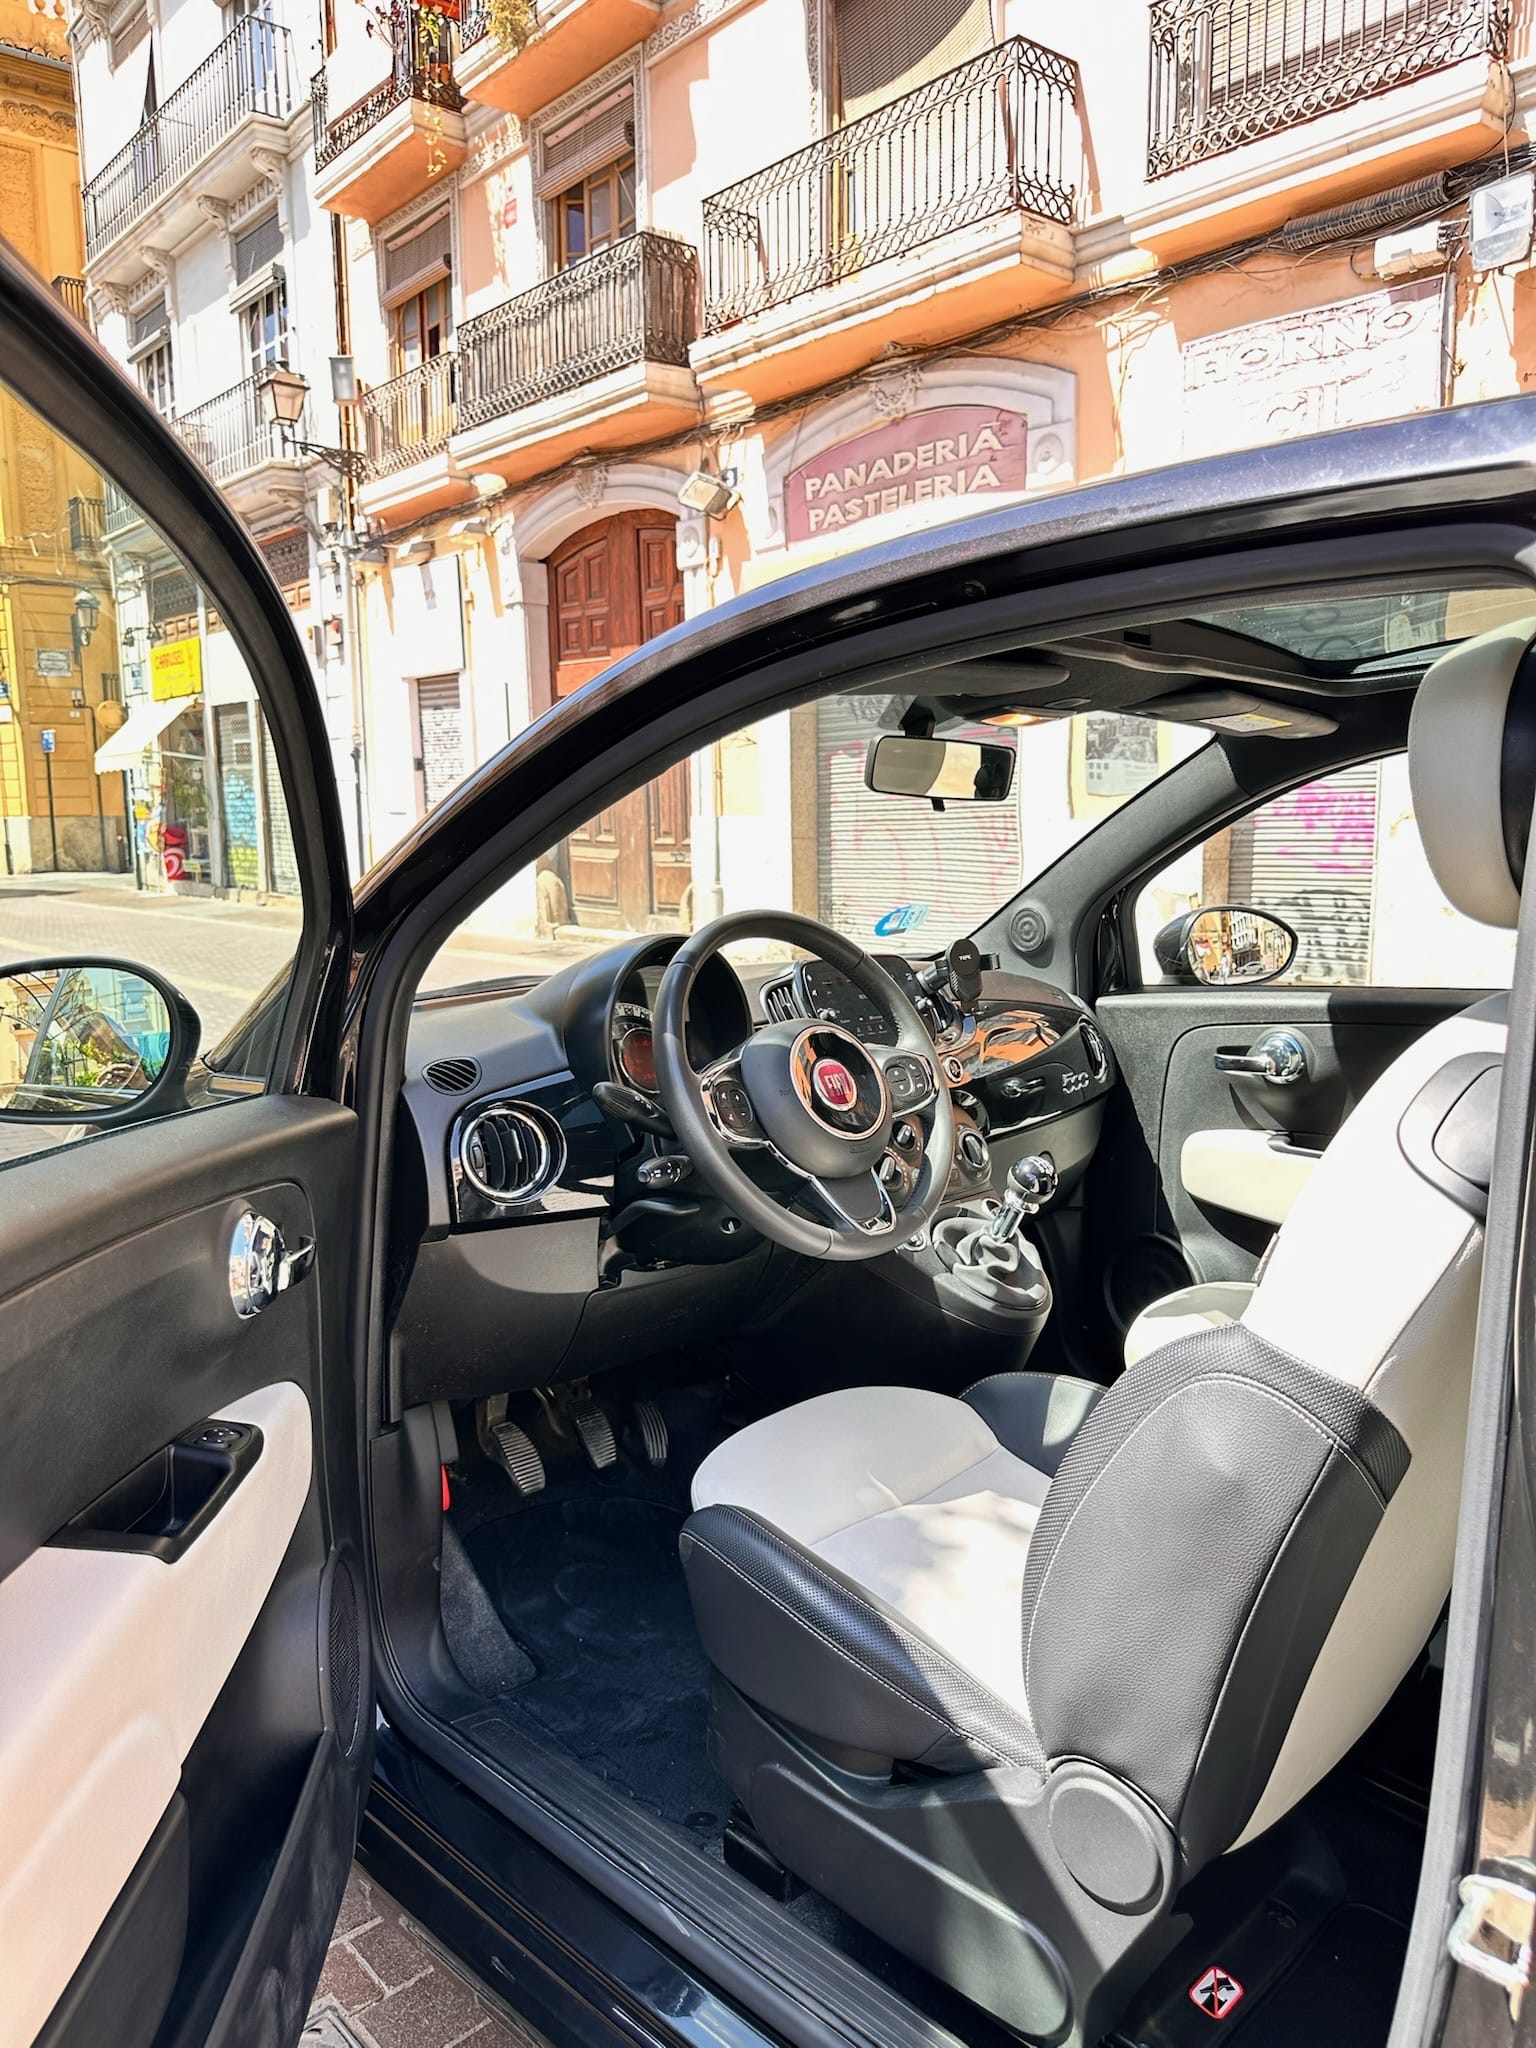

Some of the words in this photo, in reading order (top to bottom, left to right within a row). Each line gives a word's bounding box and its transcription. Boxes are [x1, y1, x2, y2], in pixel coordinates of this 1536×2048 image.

[804, 427, 1004, 501] PANADERIA
[808, 463, 1002, 532] PASTELERIA
[823, 1072, 850, 1097] FIAT
[1062, 1072, 1089, 1094] 500
